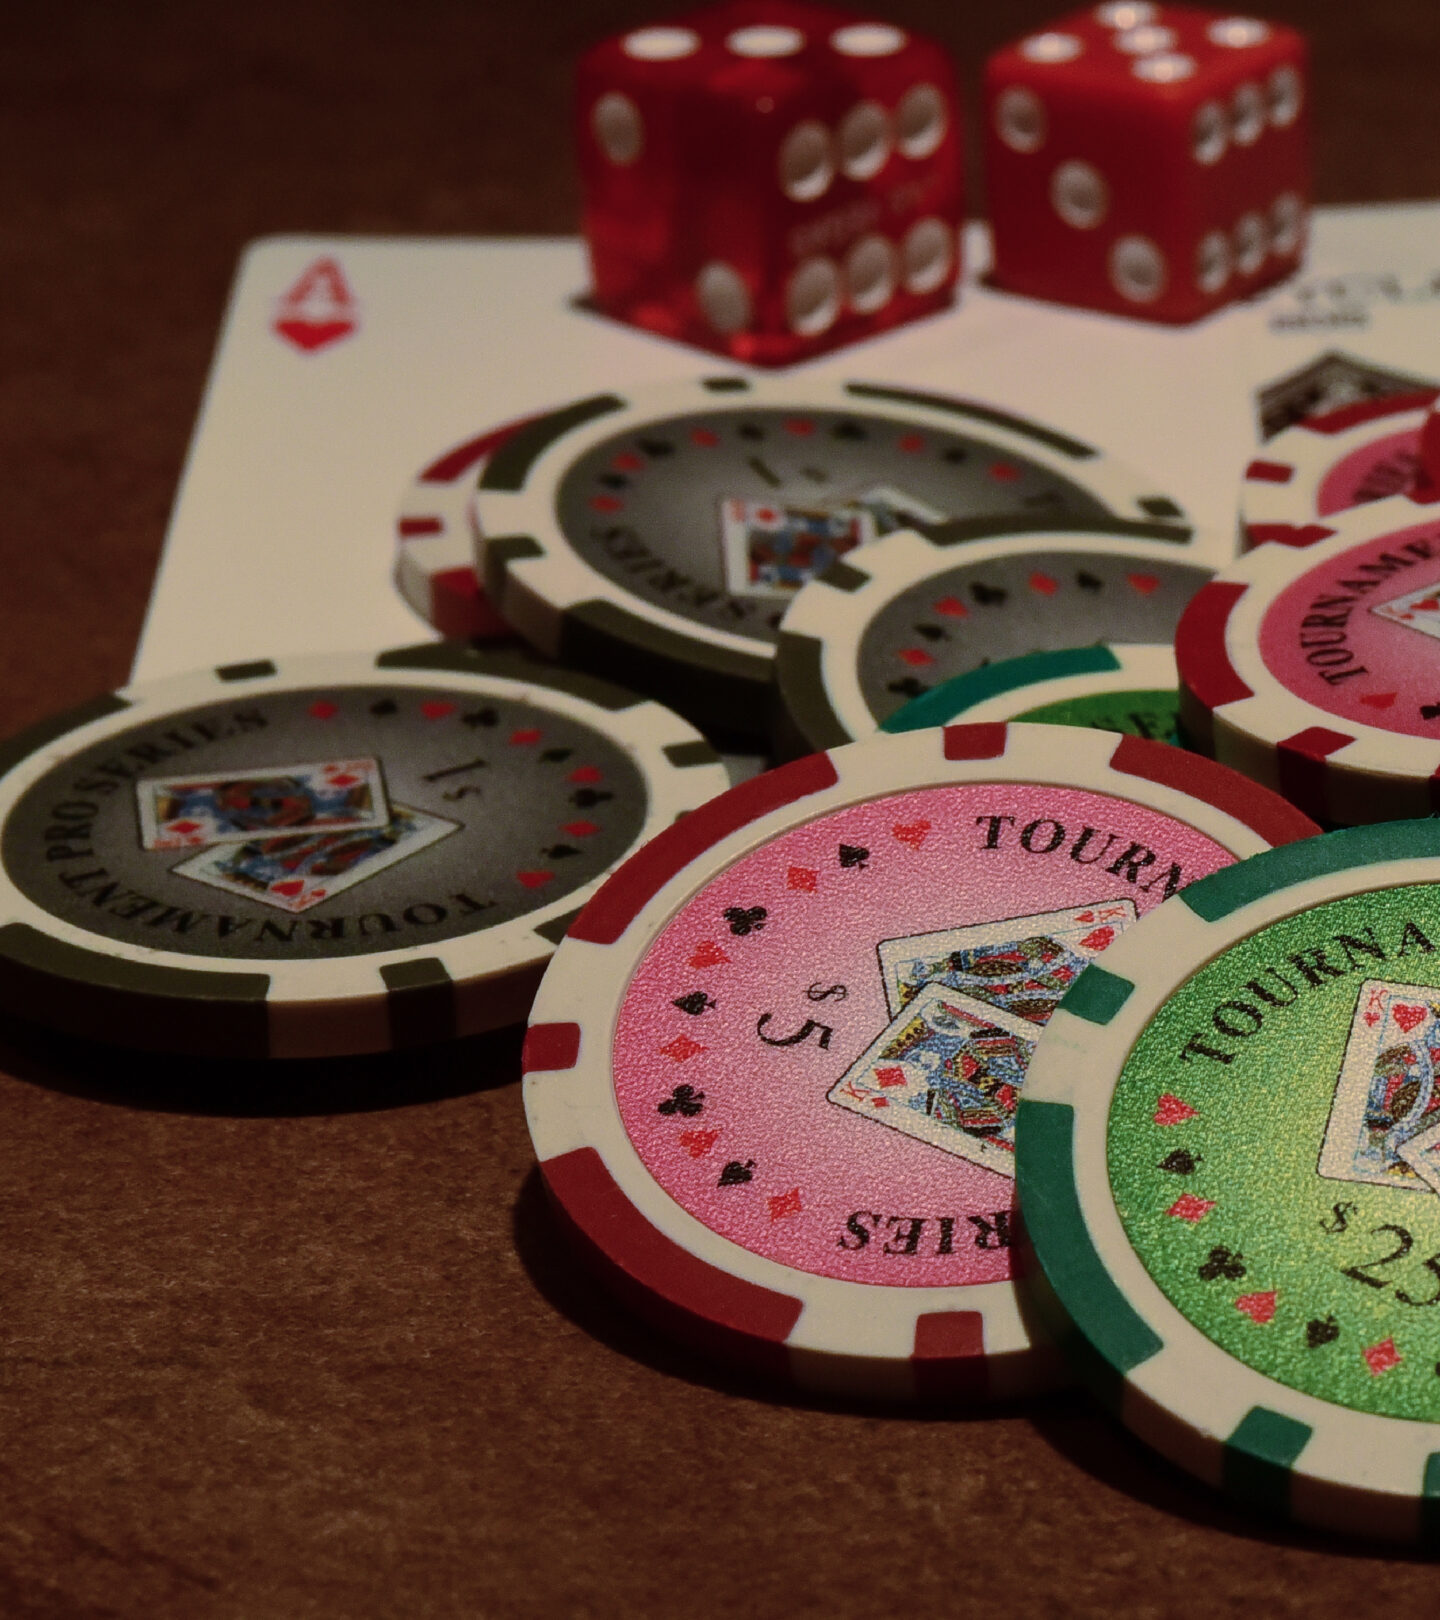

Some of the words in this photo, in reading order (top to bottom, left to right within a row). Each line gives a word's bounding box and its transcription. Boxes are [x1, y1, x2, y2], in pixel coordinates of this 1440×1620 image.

[283, 256, 354, 318] A
[74, 708, 269, 796] SERIES
[44, 800, 100, 862] PRO
[58, 866, 497, 942] TOURNAMENT
[1367, 988, 1389, 1011] K
